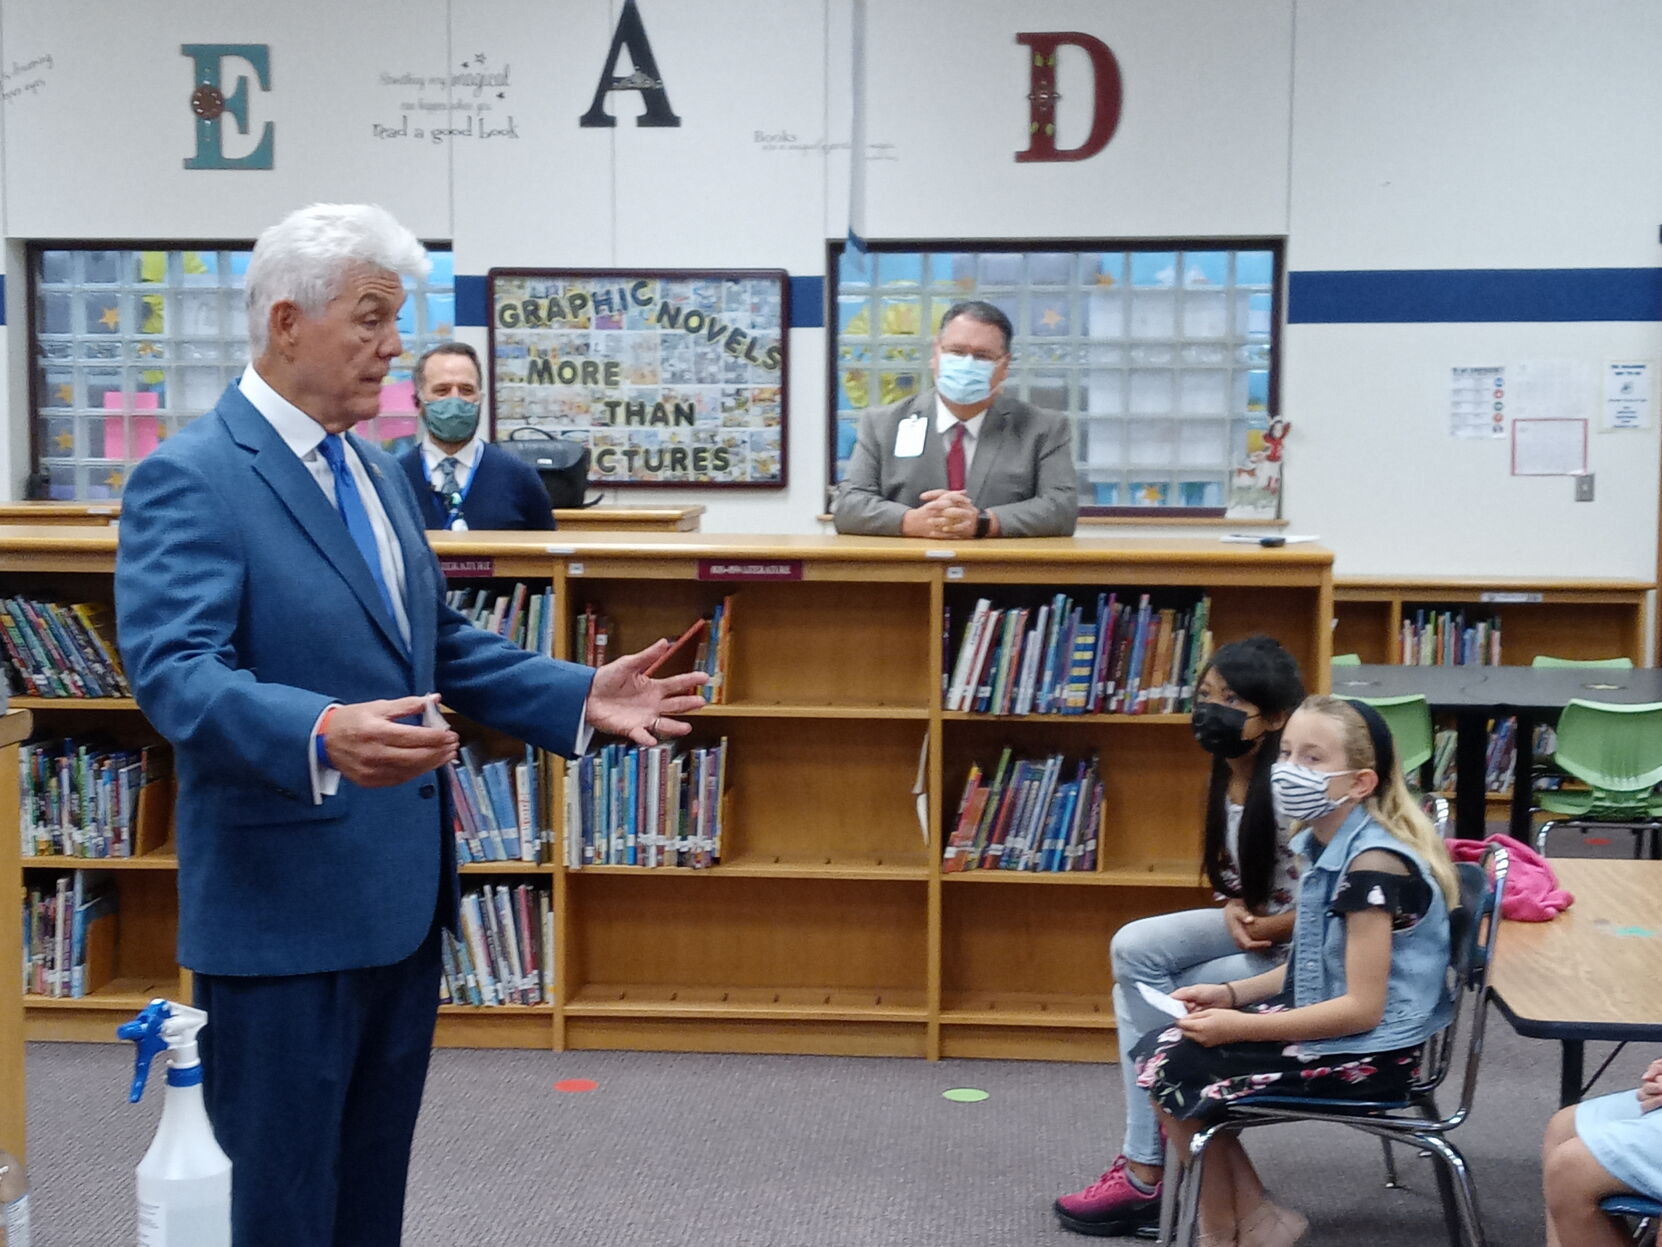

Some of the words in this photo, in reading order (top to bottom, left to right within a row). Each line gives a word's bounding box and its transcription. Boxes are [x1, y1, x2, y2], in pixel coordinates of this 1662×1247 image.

[181, 44, 274, 170] E
[579, 0, 681, 127] A
[1015, 31, 1123, 163] D
[413, 127, 425, 139] a
[430, 115, 473, 144] good
[499, 280, 654, 329] GRAPHIC
[656, 301, 783, 370] NOVELS
[527, 358, 621, 386] MORE
[604, 401, 696, 427] THAN
[595, 447, 731, 474] CTURES
